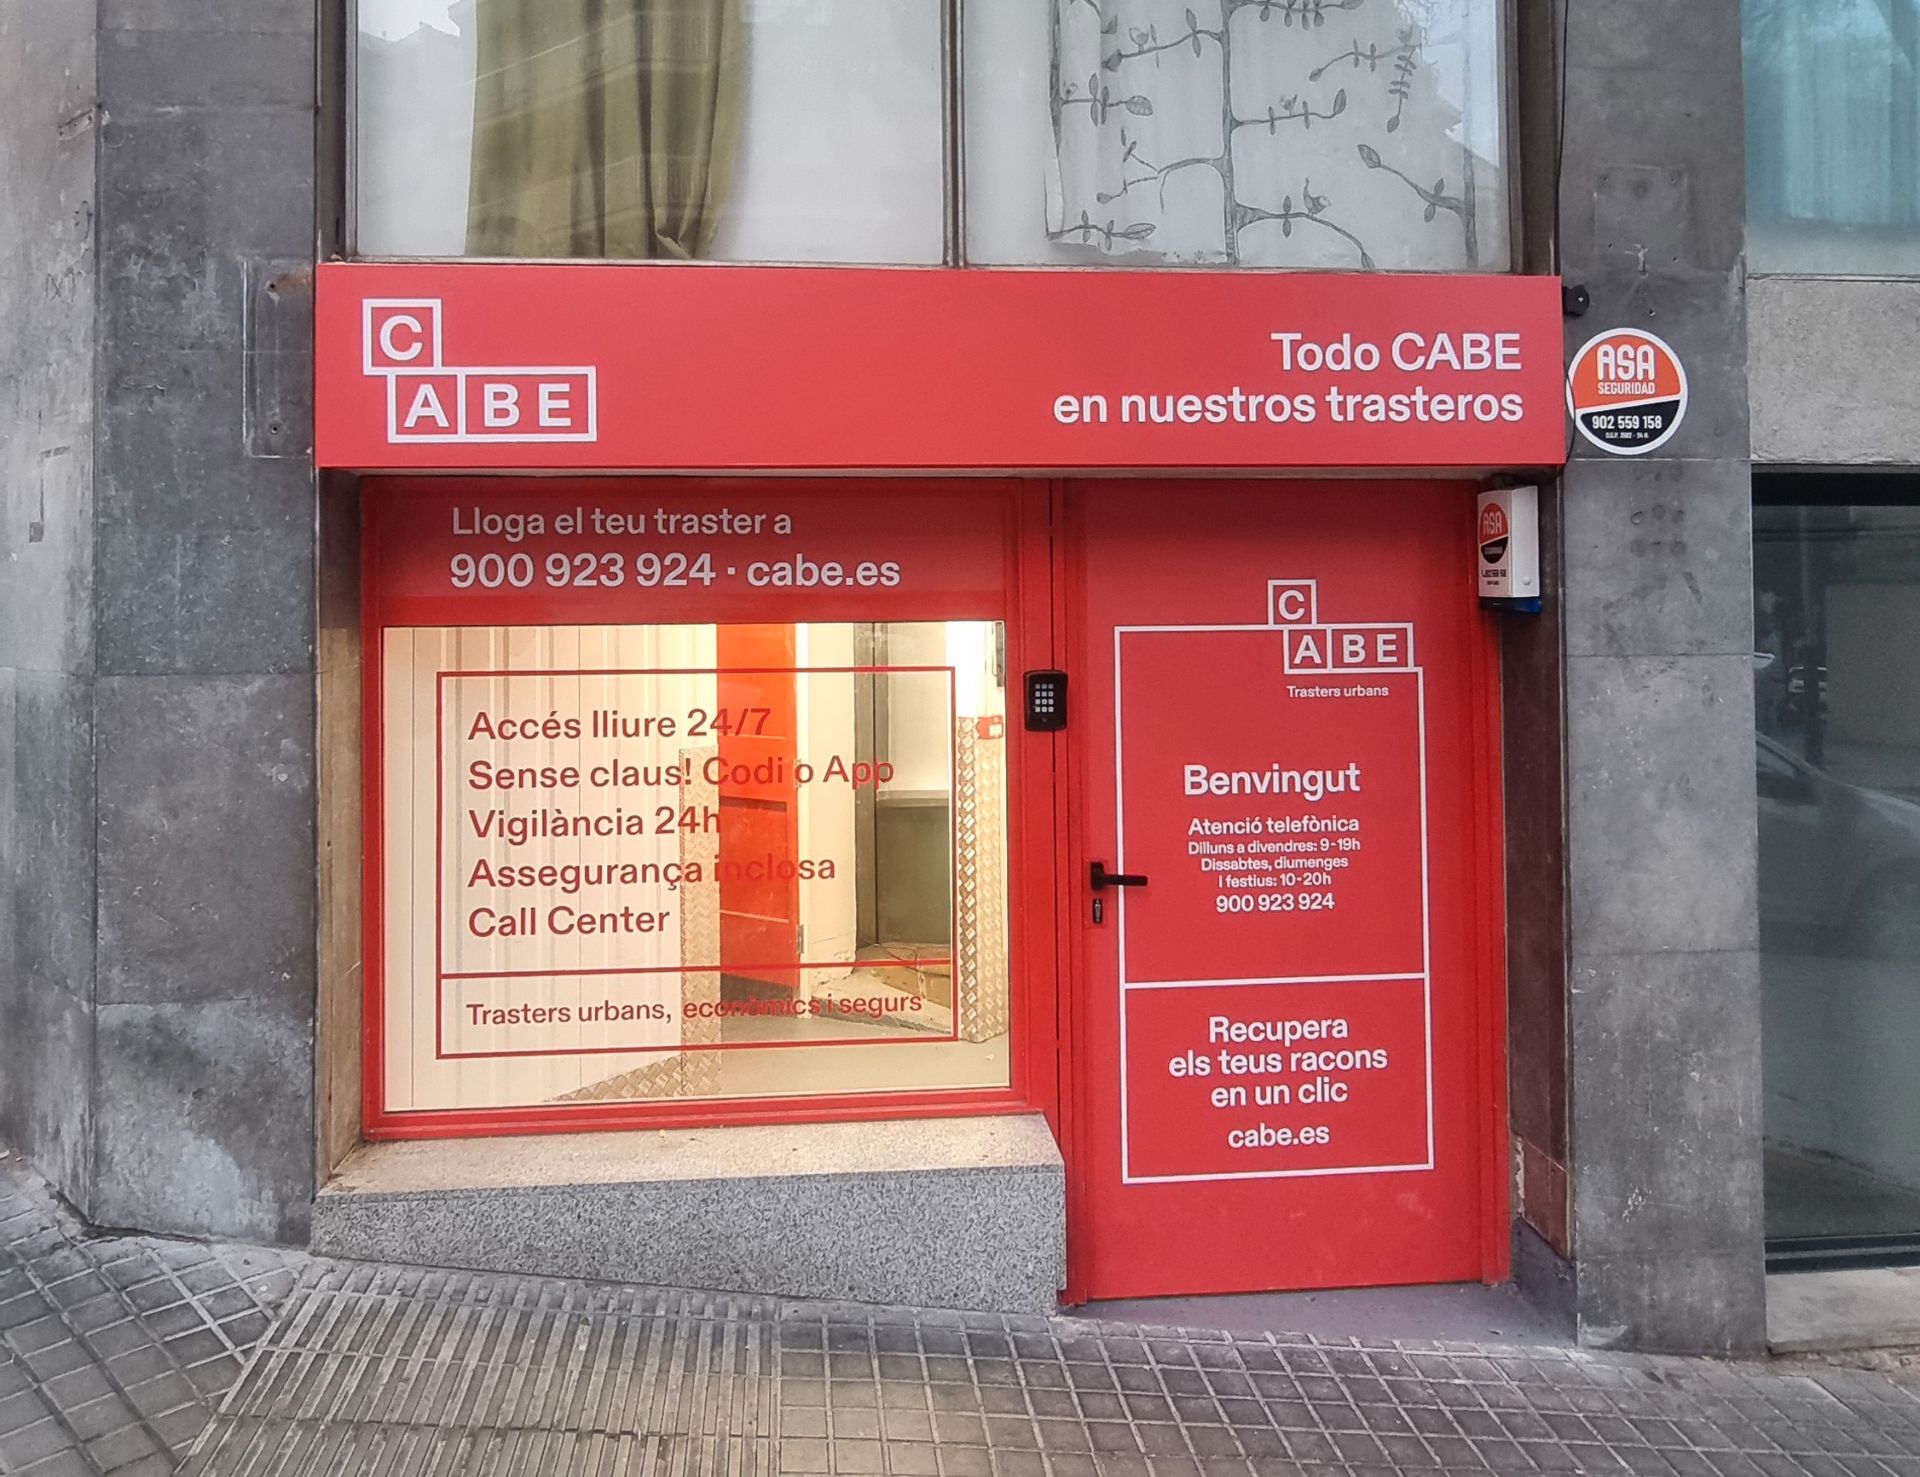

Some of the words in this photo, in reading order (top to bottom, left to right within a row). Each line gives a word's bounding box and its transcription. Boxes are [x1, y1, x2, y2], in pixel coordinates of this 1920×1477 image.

[1270, 331, 1381, 371] Todo
[1391, 331, 1523, 371] CABE
[1596, 344, 1655, 381] ASA
[1053, 394, 1108, 424] en
[1121, 386, 1316, 423] nuestros
[1325, 385, 1523, 422] trasteros
[1597, 382, 1655, 395] SEGURIDAD
[1592, 415, 1615, 430] 902
[1617, 415, 1640, 430] 559
[1642, 415, 1663, 430] 158
[452, 506, 545, 542] Lloga
[554, 506, 583, 535] el
[591, 508, 646, 535] teu
[653, 507, 767, 535] traster
[773, 513, 792, 535] a
[1482, 511, 1503, 536] ASA
[450, 553, 534, 588] 900
[545, 553, 625, 587] 923
[636, 553, 717, 587] 924
[747, 554, 902, 588] cabe.es
[1286, 685, 1341, 698] Trasters
[1343, 684, 1389, 697] urbans
[468, 711, 581, 741] Accés
[593, 710, 676, 738] lliure
[687, 708, 772, 737] 24/7
[468, 760, 580, 790] Sense
[590, 758, 692, 787] claus!
[703, 756, 784, 785] Codi
[795, 763, 815, 784] o
[822, 755, 894, 791] App
[1184, 763, 1361, 801] Benvingut
[468, 808, 644, 846] Vigilància
[655, 806, 721, 835] 24h
[1188, 817, 1263, 836] Atenció
[1265, 814, 1359, 834] telefònica
[1188, 841, 1235, 855] Dilluns
[1236, 844, 1245, 855] a
[1247, 839, 1318, 854] divendres:
[1319, 838, 1361, 852] 9-19h
[468, 858, 703, 893] Assegurança
[714, 853, 836, 882] inclosa
[1201, 857, 1273, 873] Dissabtes,
[1274, 854, 1349, 874] diumenges
[1225, 872, 1278, 888] festius:
[1279, 871, 1332, 887] 10-20h
[1216, 894, 1255, 913] 900
[1257, 893, 1295, 912] 923
[1298, 892, 1336, 911] 924
[468, 907, 537, 938] Call
[547, 904, 671, 935] Center
[466, 1002, 571, 1026] Trasters
[577, 999, 672, 1025] urbans,
[683, 994, 822, 1019] econòmics
[826, 993, 834, 1013] i
[839, 995, 923, 1020] segurs
[1208, 1016, 1349, 1047] Recupera
[1168, 1051, 1211, 1077] els
[1217, 1050, 1282, 1076] teus
[1290, 1049, 1388, 1073] racons
[1210, 1086, 1247, 1108] en
[1255, 1084, 1290, 1106] un
[1298, 1076, 1349, 1104] clic
[1227, 1122, 1330, 1149] cabe.es
